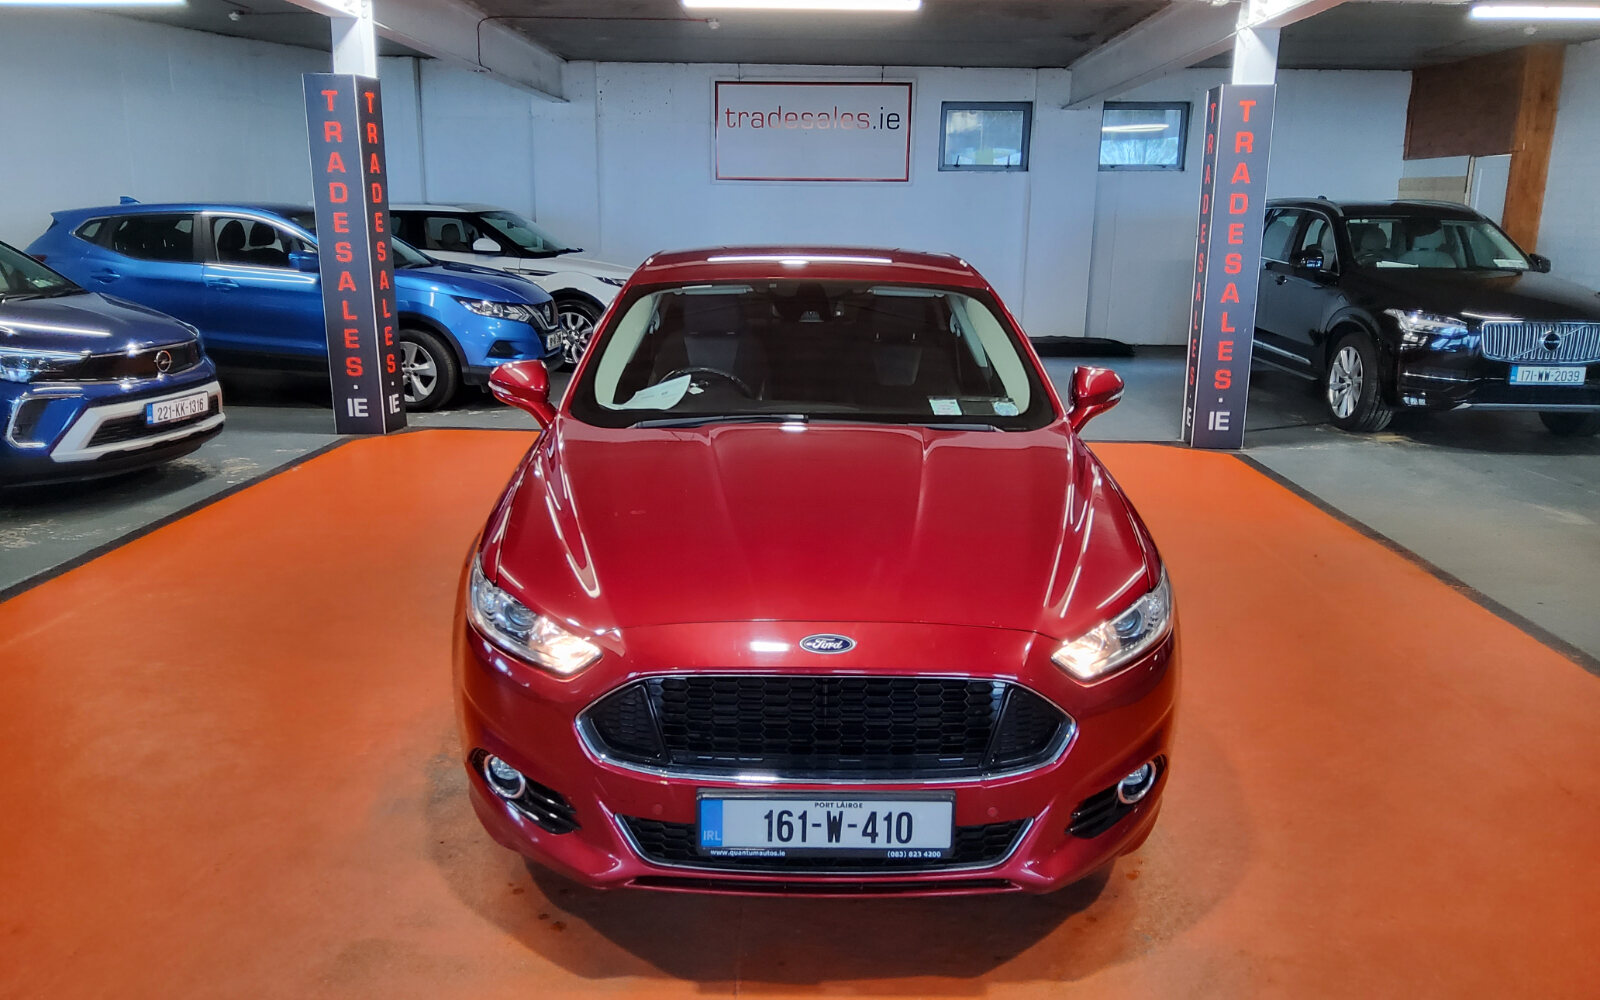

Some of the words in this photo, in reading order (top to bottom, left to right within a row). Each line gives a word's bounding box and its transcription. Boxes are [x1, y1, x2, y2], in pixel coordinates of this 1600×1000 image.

[725, 105, 901, 130] tradesales.ie
[157, 398, 204, 421] 221-KK-1316
[806, 637, 843, 650] Ford
[703, 830, 722, 841] IRL
[763, 809, 914, 845] 161-W-410
[923, 850, 942, 858] 4200
